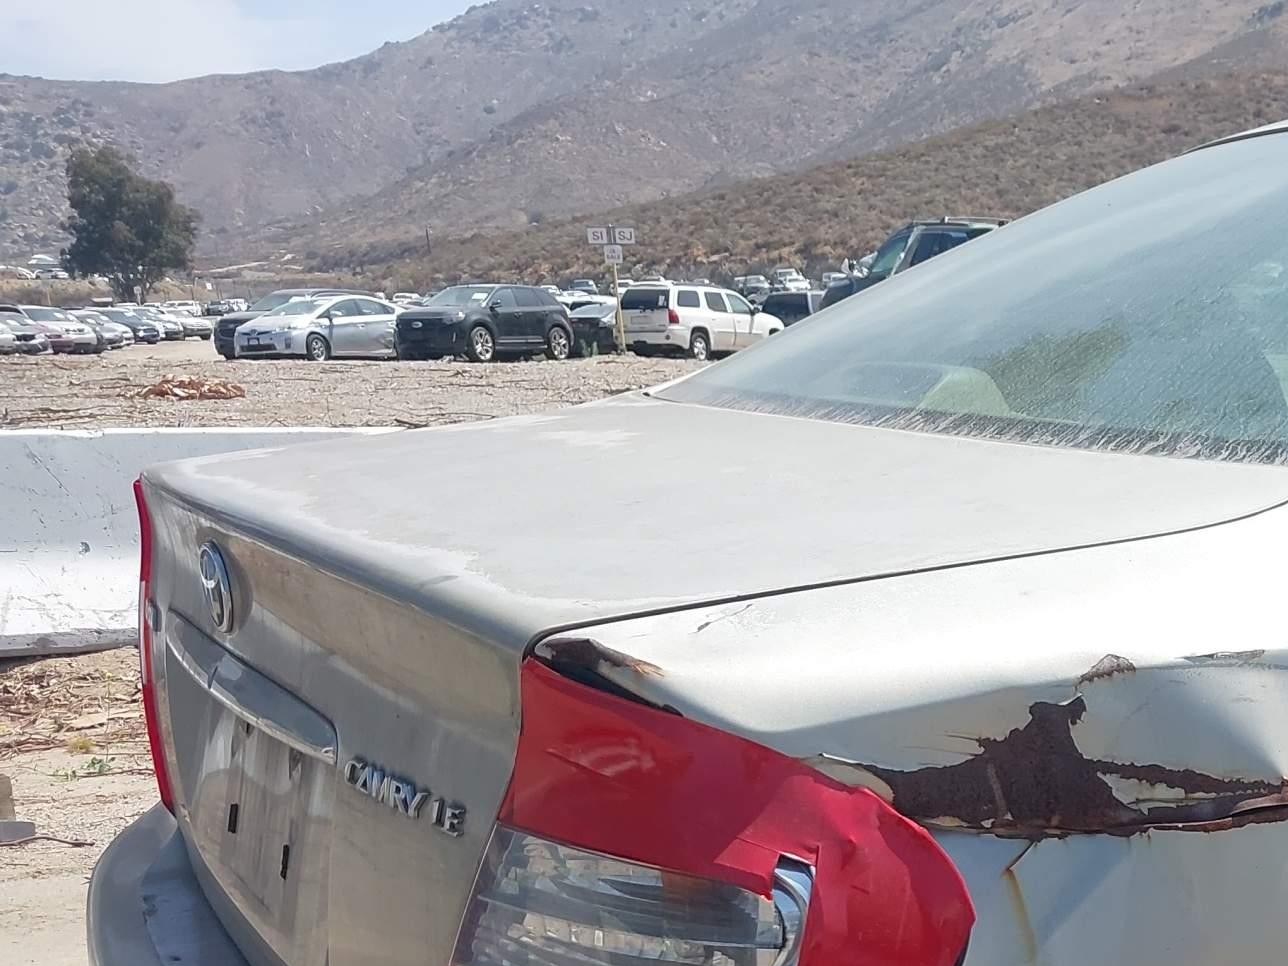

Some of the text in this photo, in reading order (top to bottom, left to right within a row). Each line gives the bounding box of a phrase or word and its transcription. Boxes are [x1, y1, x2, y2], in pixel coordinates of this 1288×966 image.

[618, 230, 633, 241] SJ
[344, 760, 466, 838] CAMRY LE
